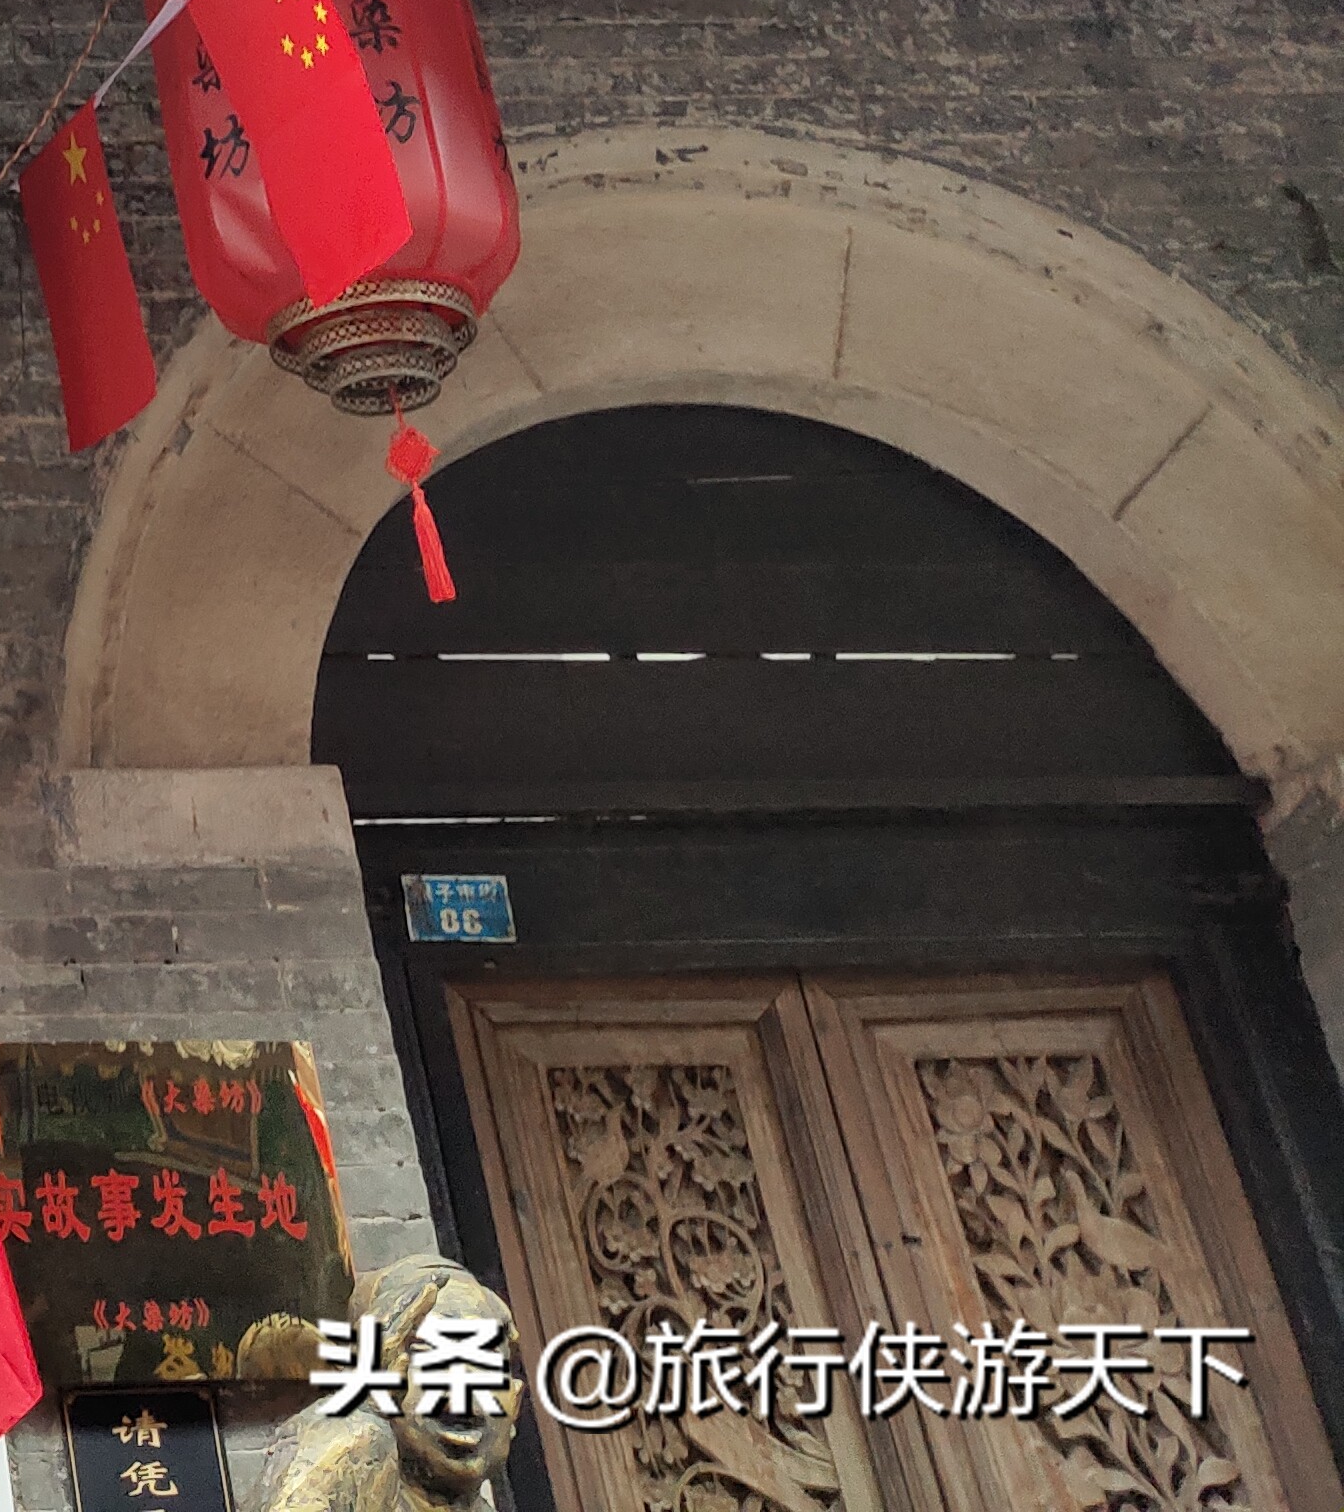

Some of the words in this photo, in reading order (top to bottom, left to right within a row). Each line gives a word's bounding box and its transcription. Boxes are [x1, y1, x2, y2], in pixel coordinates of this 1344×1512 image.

[140, 1078, 263, 1117] 《大染坊》
[92, 1296, 210, 1332] 《大染坊》
[111, 1408, 180, 1512] 请凭
